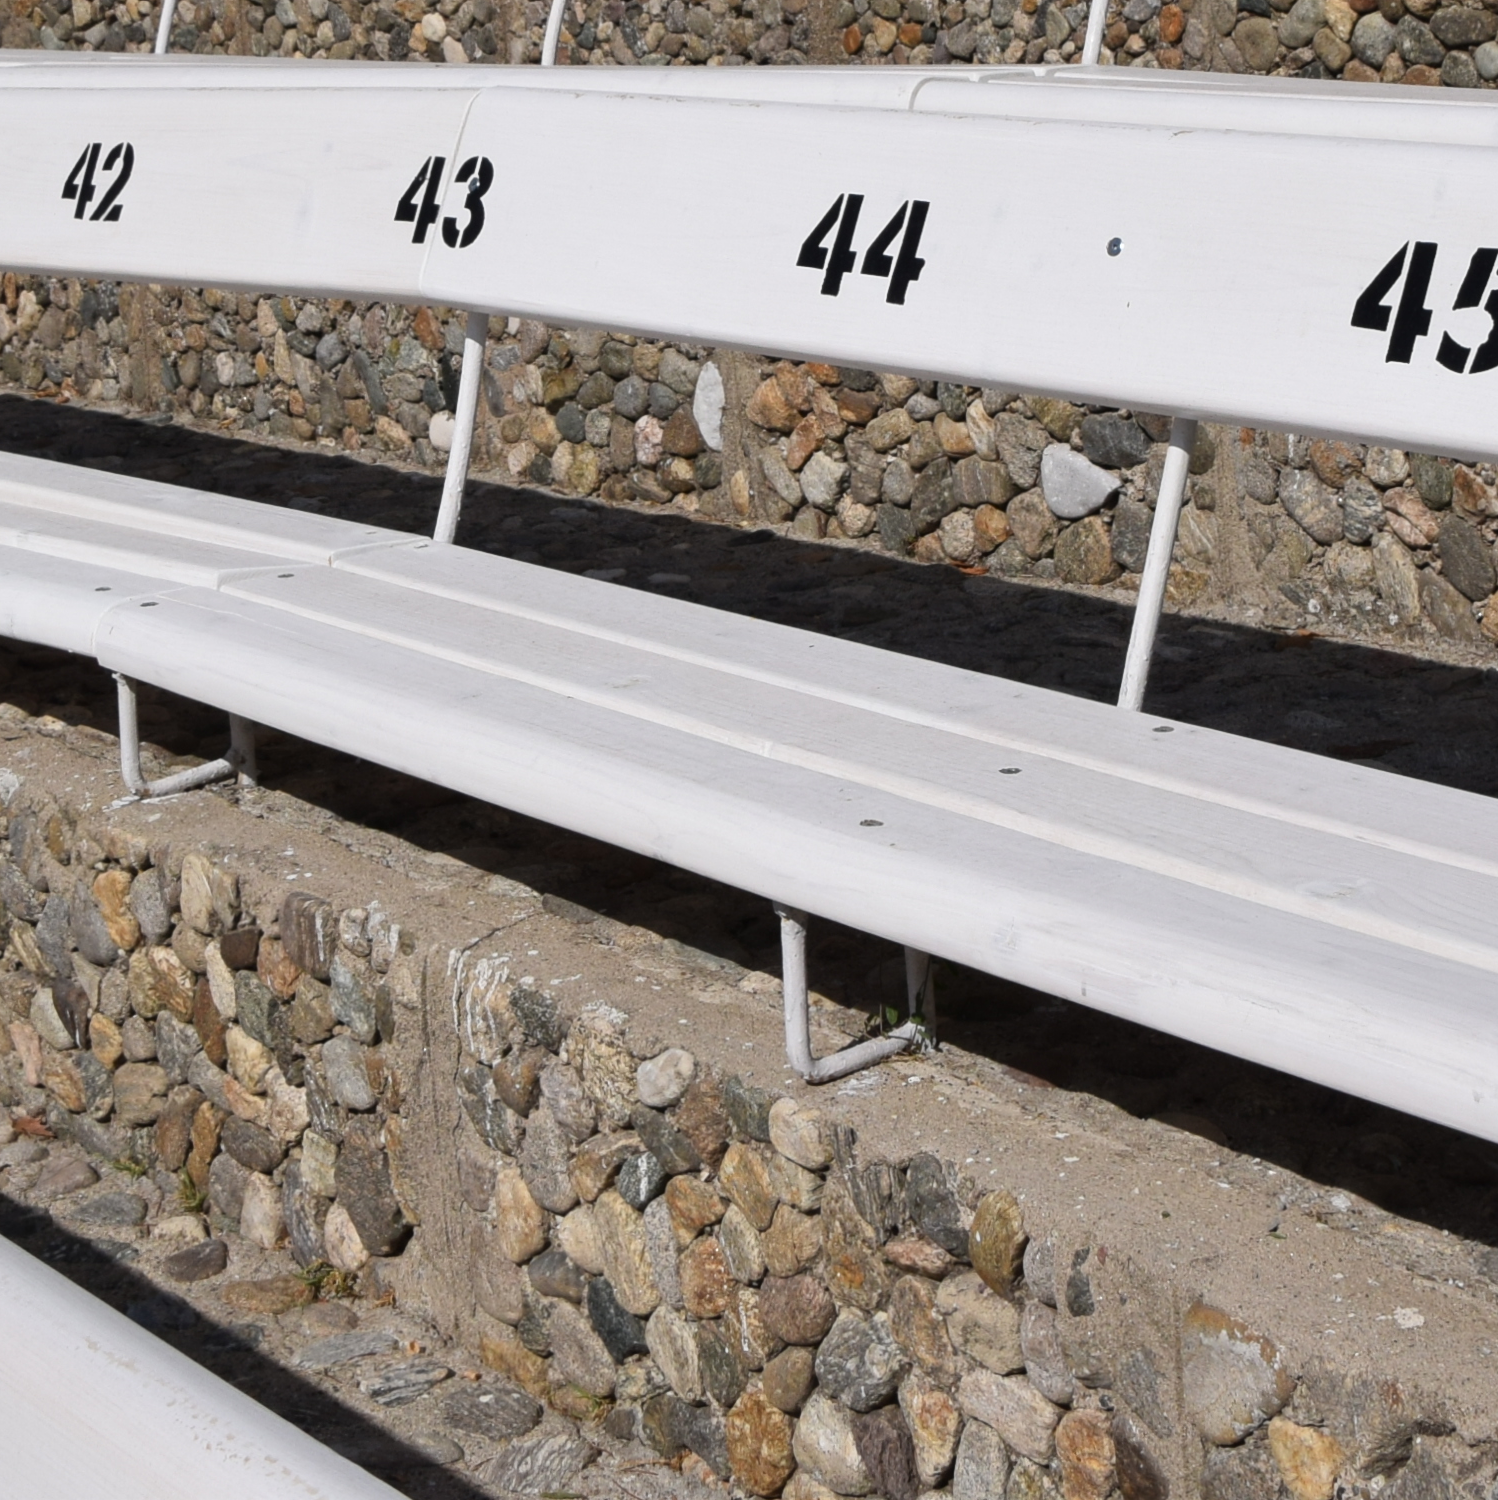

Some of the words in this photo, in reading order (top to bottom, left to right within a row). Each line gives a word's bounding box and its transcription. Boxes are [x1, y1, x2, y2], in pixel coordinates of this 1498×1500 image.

[62, 143, 134, 221] 42
[394, 157, 493, 248] 43
[796, 194, 930, 305] 44
